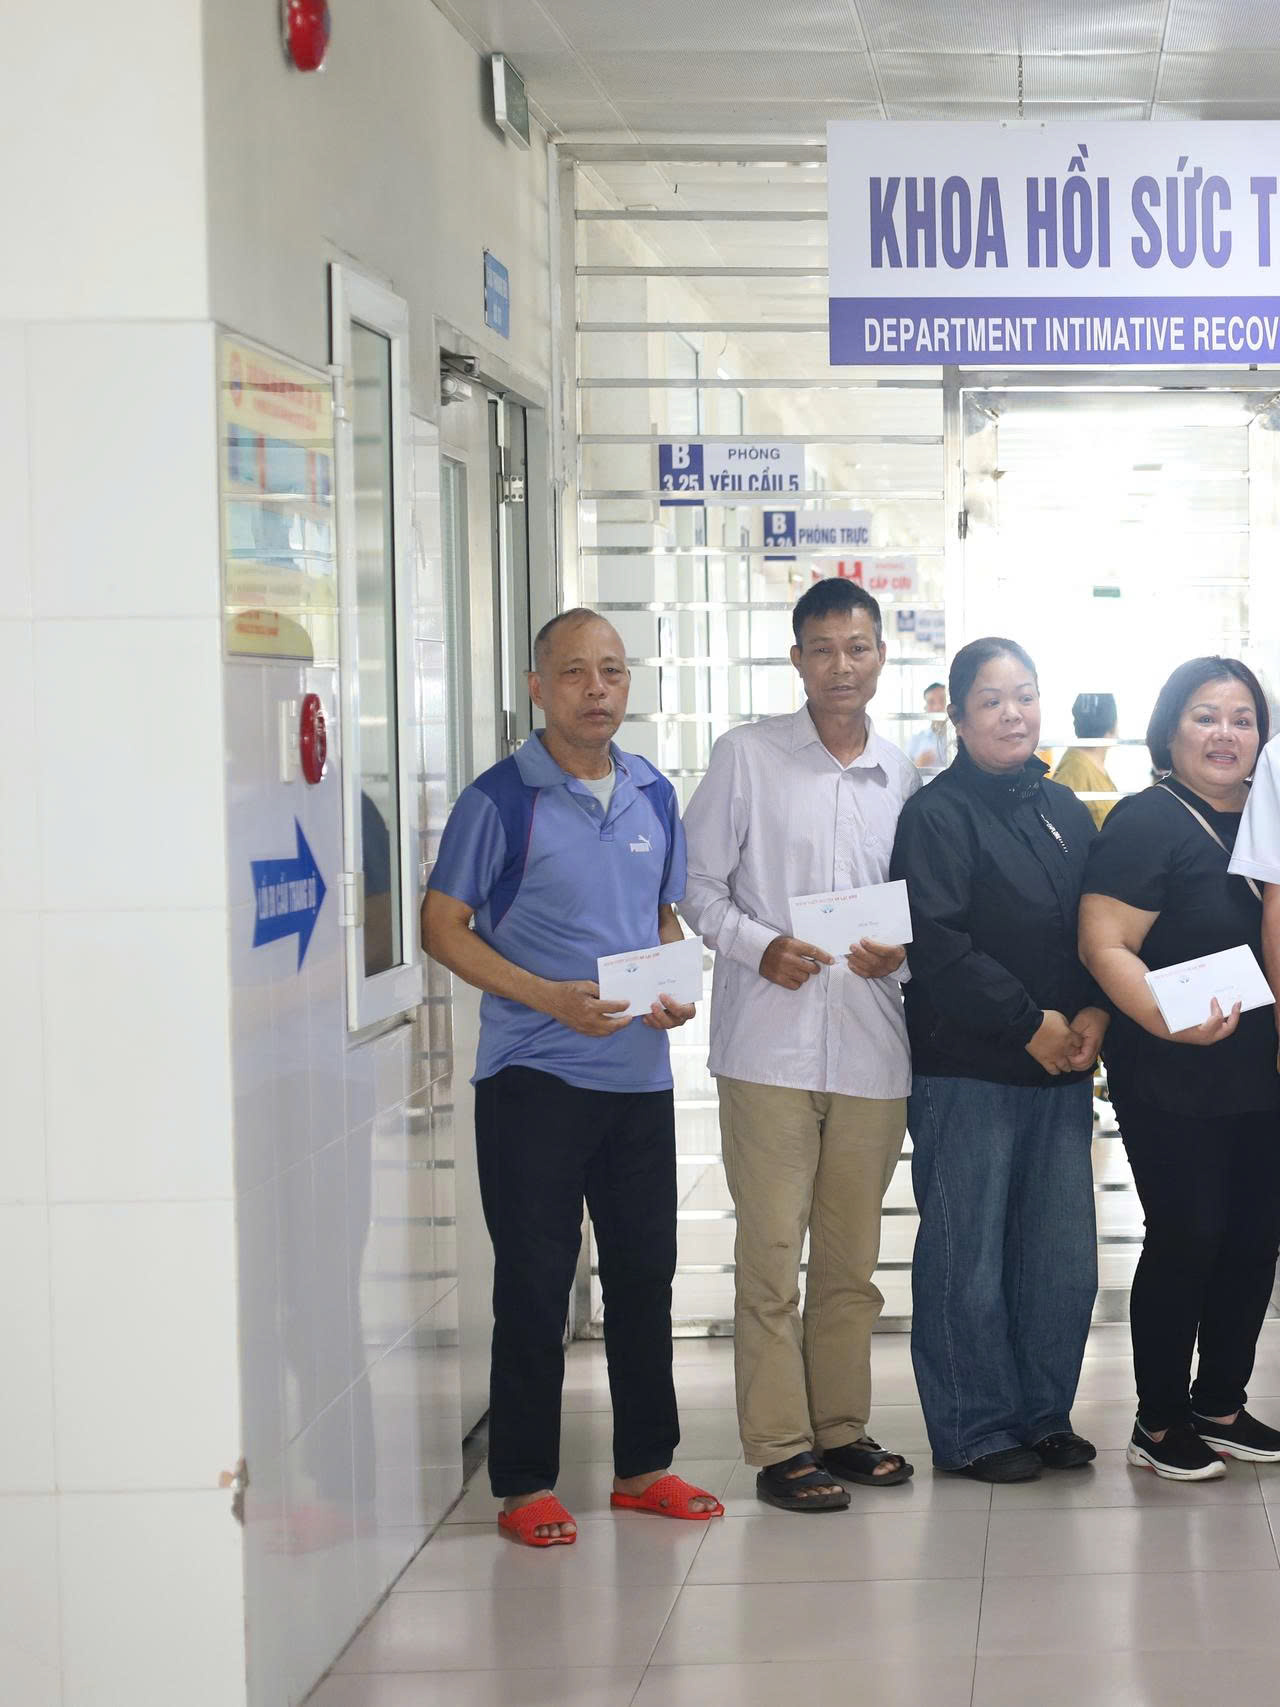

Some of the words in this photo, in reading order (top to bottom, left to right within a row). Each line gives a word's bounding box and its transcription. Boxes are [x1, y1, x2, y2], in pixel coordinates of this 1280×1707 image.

[869, 175, 1009, 269] KHOA
[1026, 143, 1111, 269] HỒI
[1131, 155, 1232, 269] SỨC
[864, 317, 1037, 352] DEPARTMENT
[1045, 317, 1185, 351] INTIMATIVE
[672, 444, 690, 469] B
[728, 446, 780, 460] PHÒNG
[710, 470, 742, 491] YÊU
[789, 474, 799, 491] 5
[772, 513, 787, 534] B
